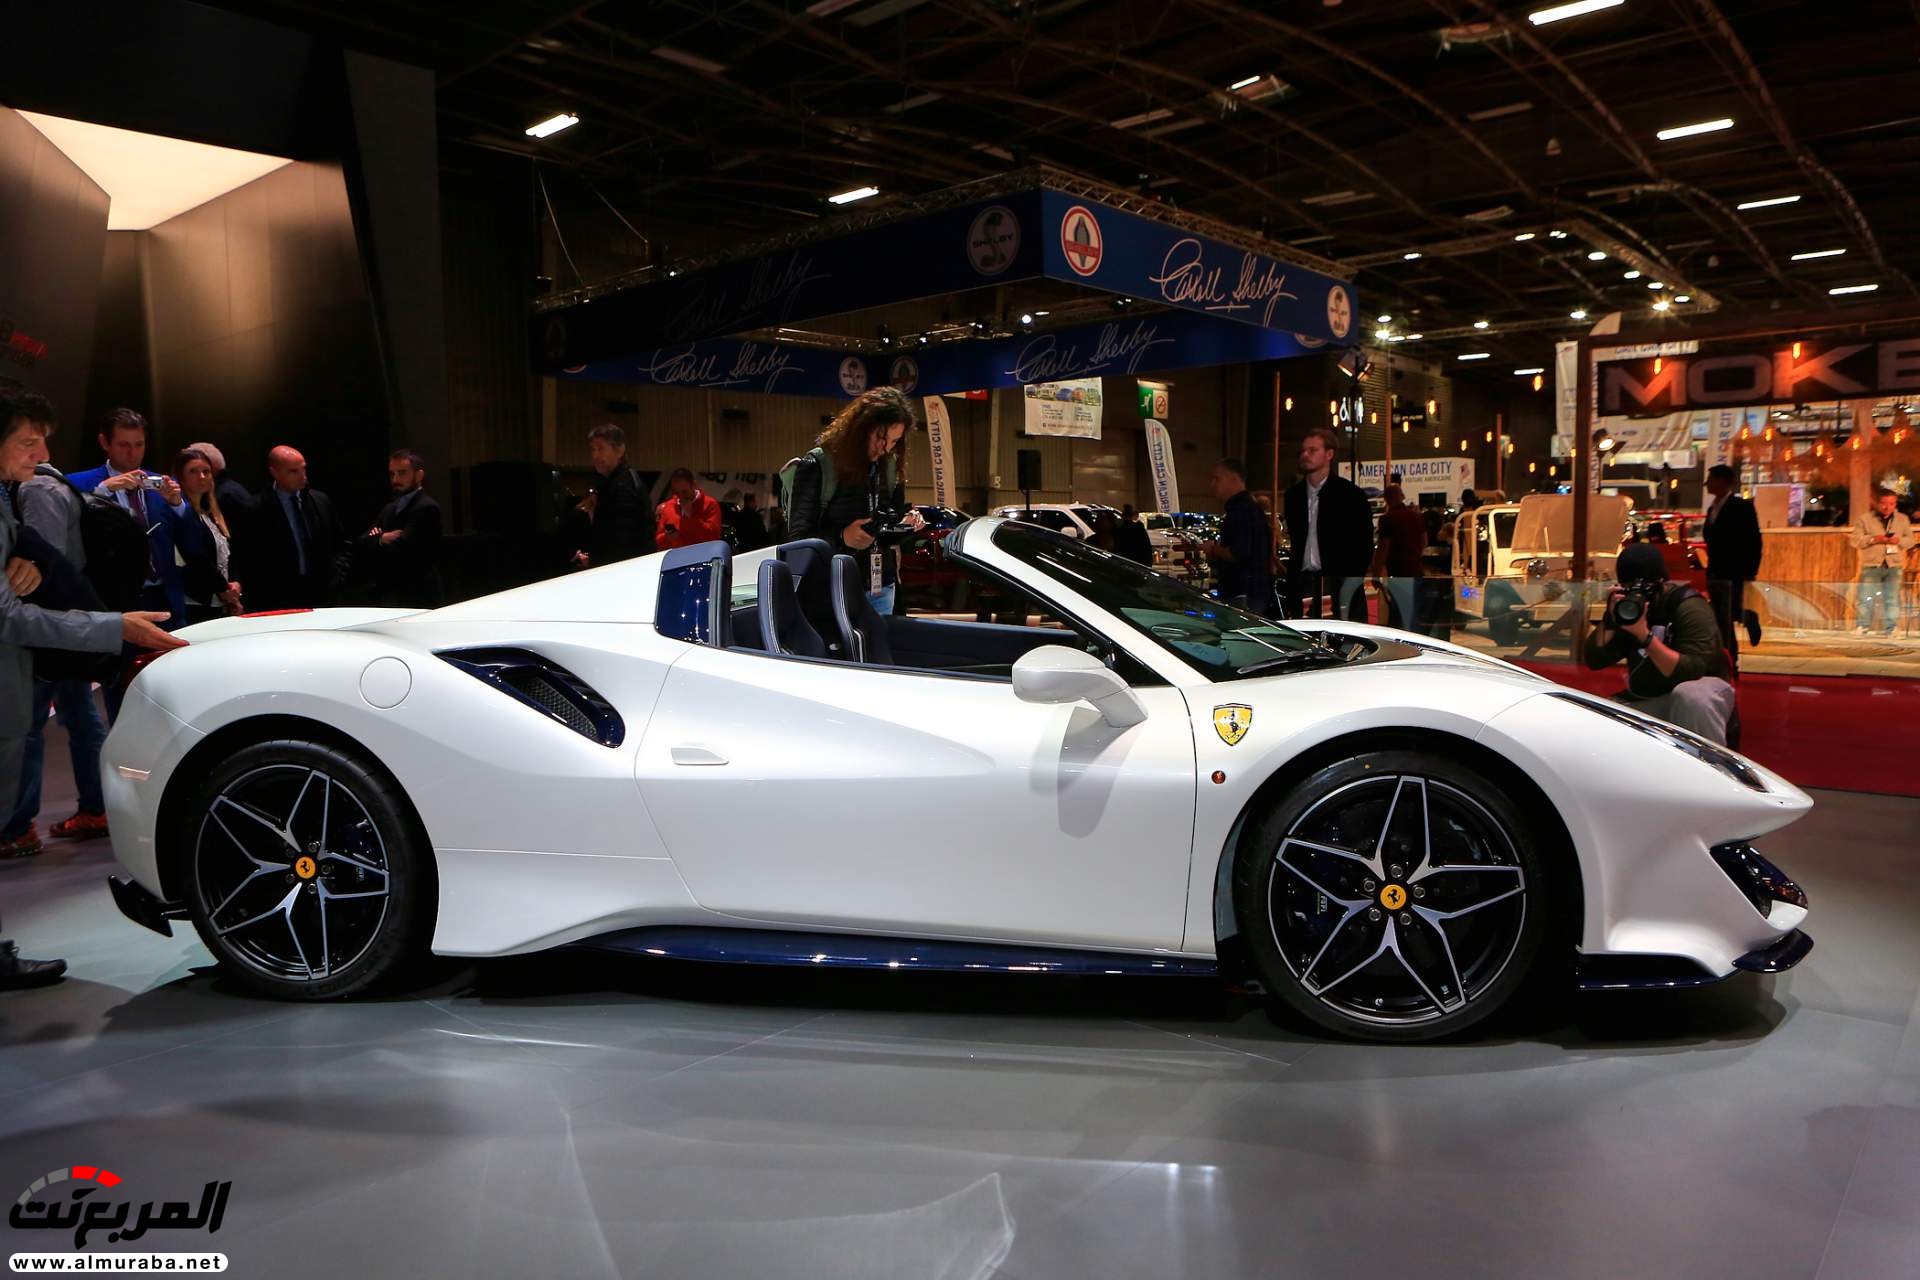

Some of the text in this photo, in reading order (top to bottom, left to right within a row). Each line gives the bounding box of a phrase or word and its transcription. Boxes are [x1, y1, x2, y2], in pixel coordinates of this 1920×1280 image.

[1232, 252, 1298, 328] Shelby
[729, 341, 804, 393] Shelby
[1088, 320, 1176, 375] Shelby
[1605, 339, 1920, 408] MOKE
[1409, 463, 1428, 476] CAR
[1430, 461, 1452, 475] CITY
